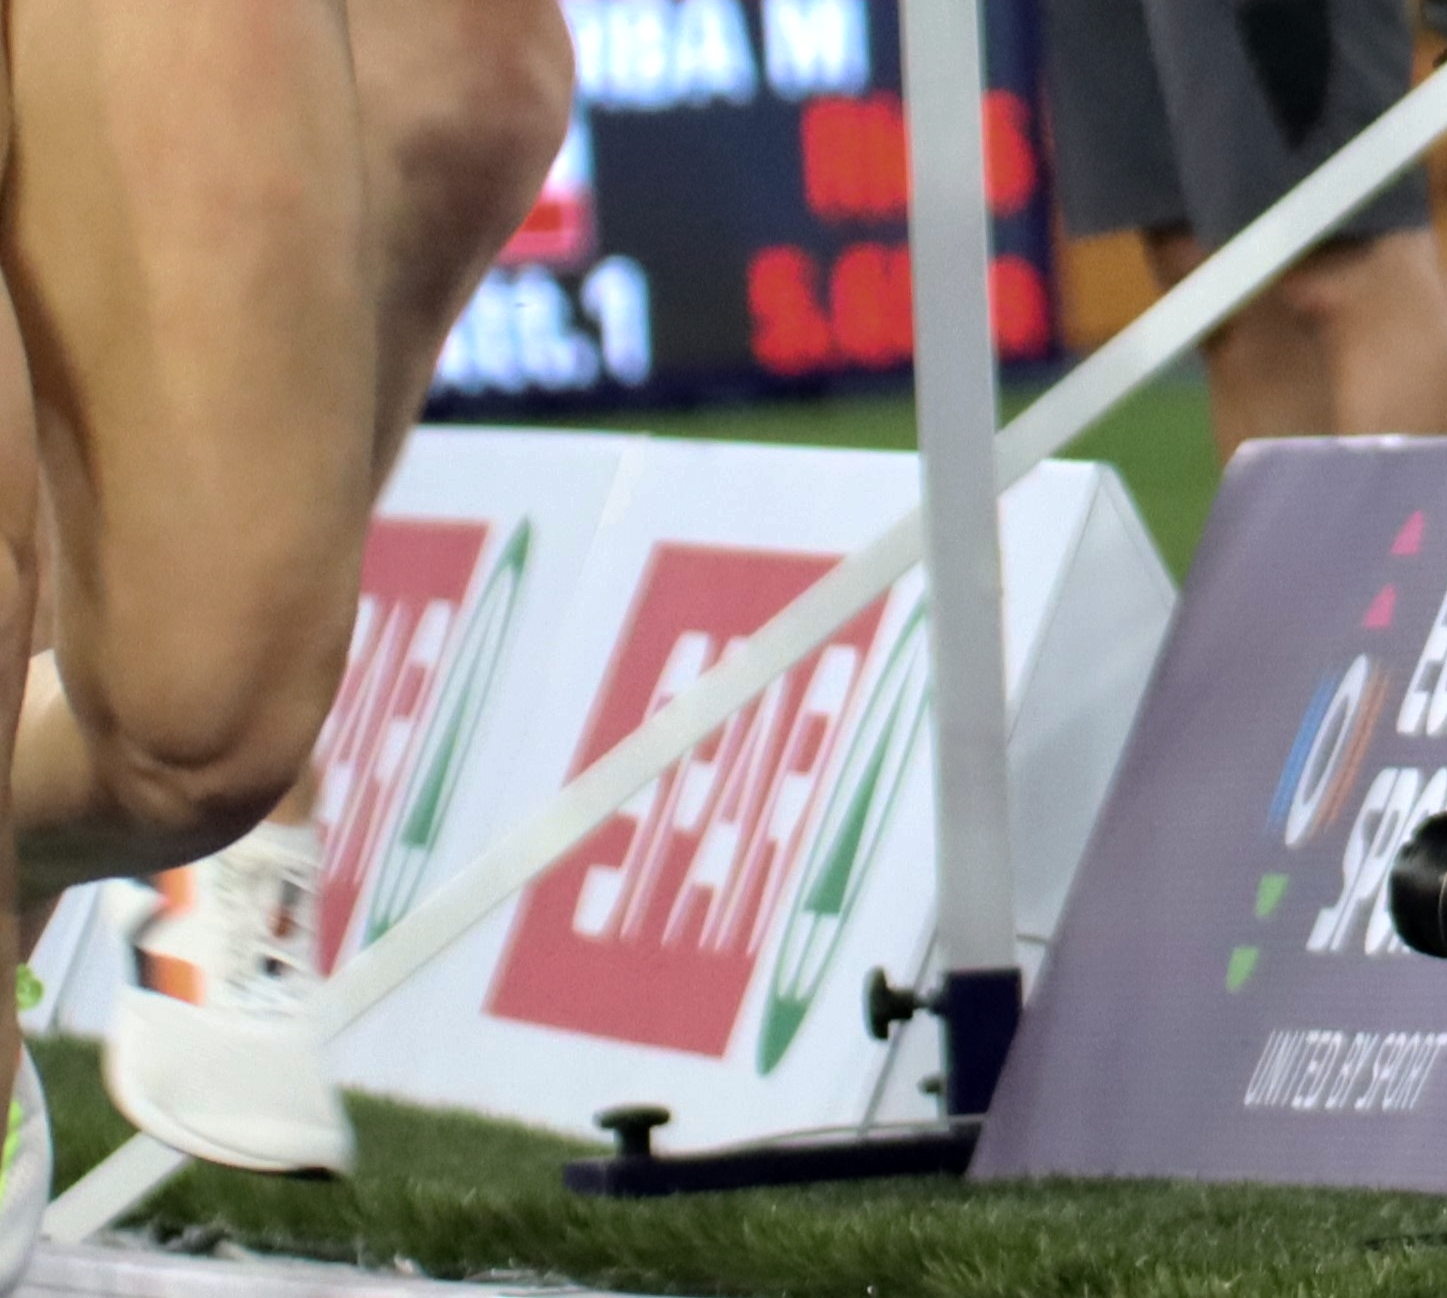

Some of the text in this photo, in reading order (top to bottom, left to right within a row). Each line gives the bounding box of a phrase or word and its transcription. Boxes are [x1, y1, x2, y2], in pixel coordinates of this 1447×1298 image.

[312, 595, 452, 885] AR
[1244, 1029, 1344, 1109] UNITED
[1324, 1030, 1380, 1109] BY
